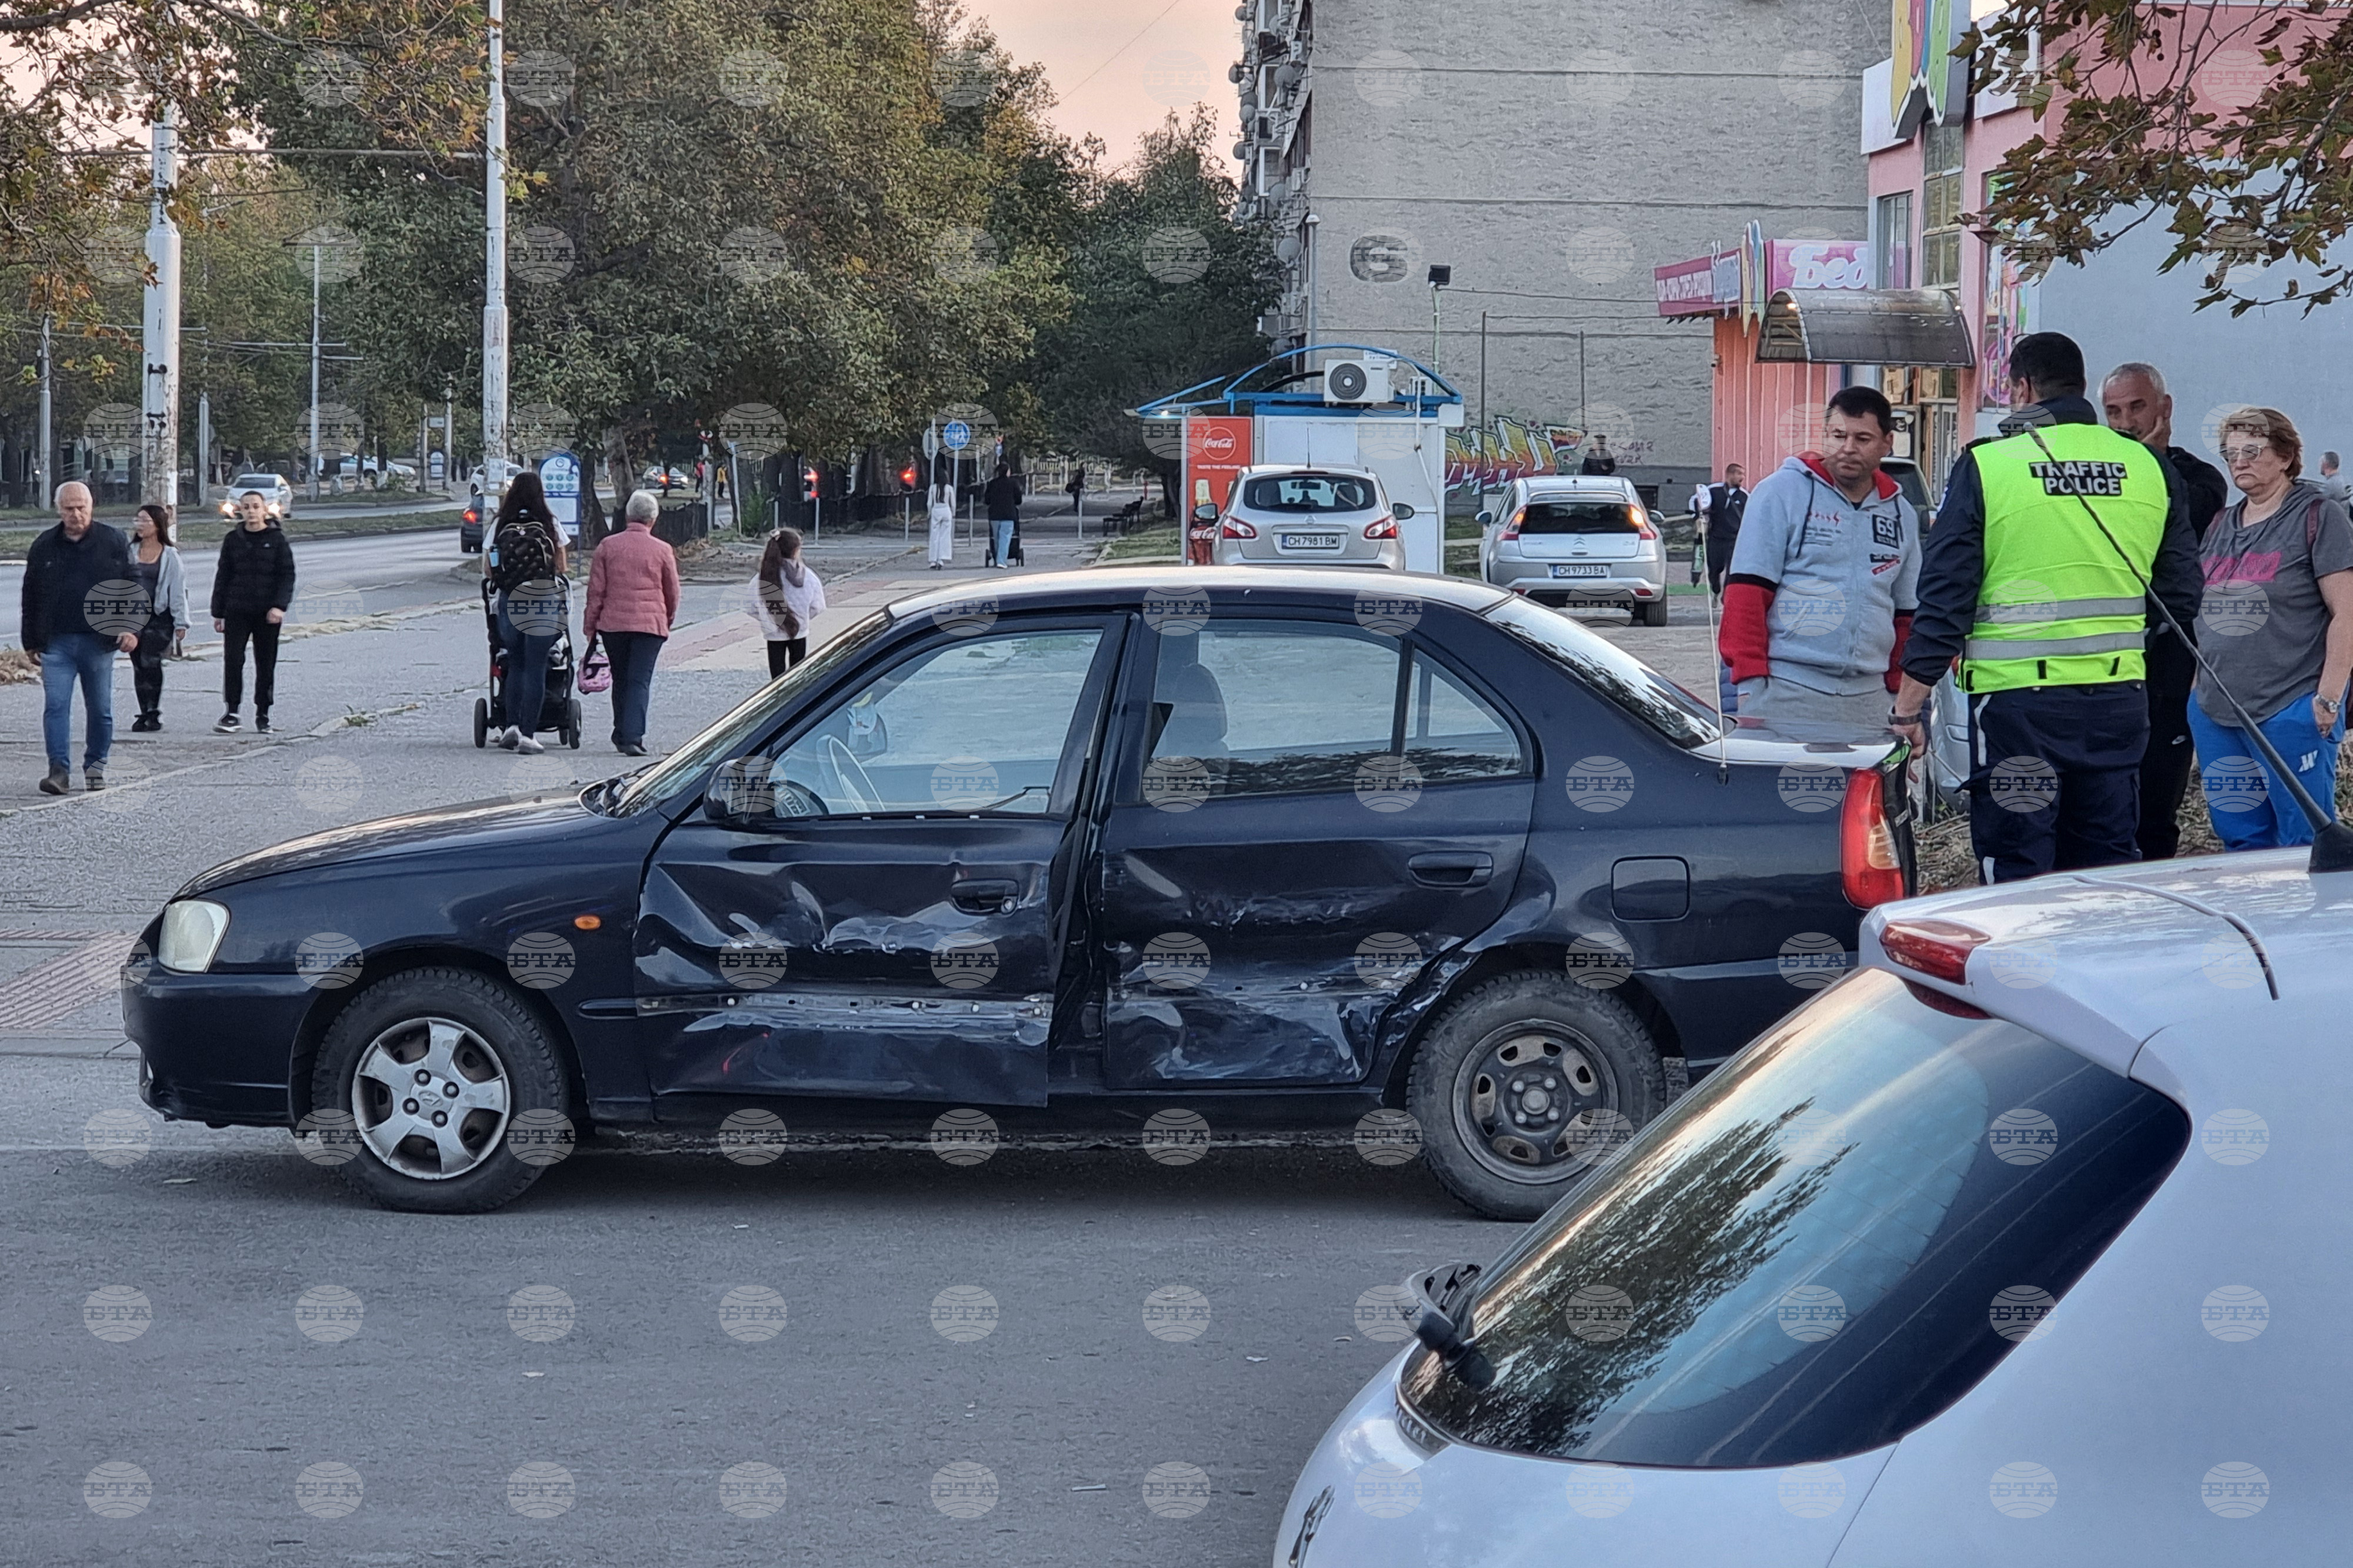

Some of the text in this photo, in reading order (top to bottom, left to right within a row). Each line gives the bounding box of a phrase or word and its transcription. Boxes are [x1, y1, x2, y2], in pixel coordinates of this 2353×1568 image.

[2030, 462, 2126, 478] TRAFFIC
[2045, 477, 2121, 495] POLICE
[1875, 516, 1895, 538] 69
